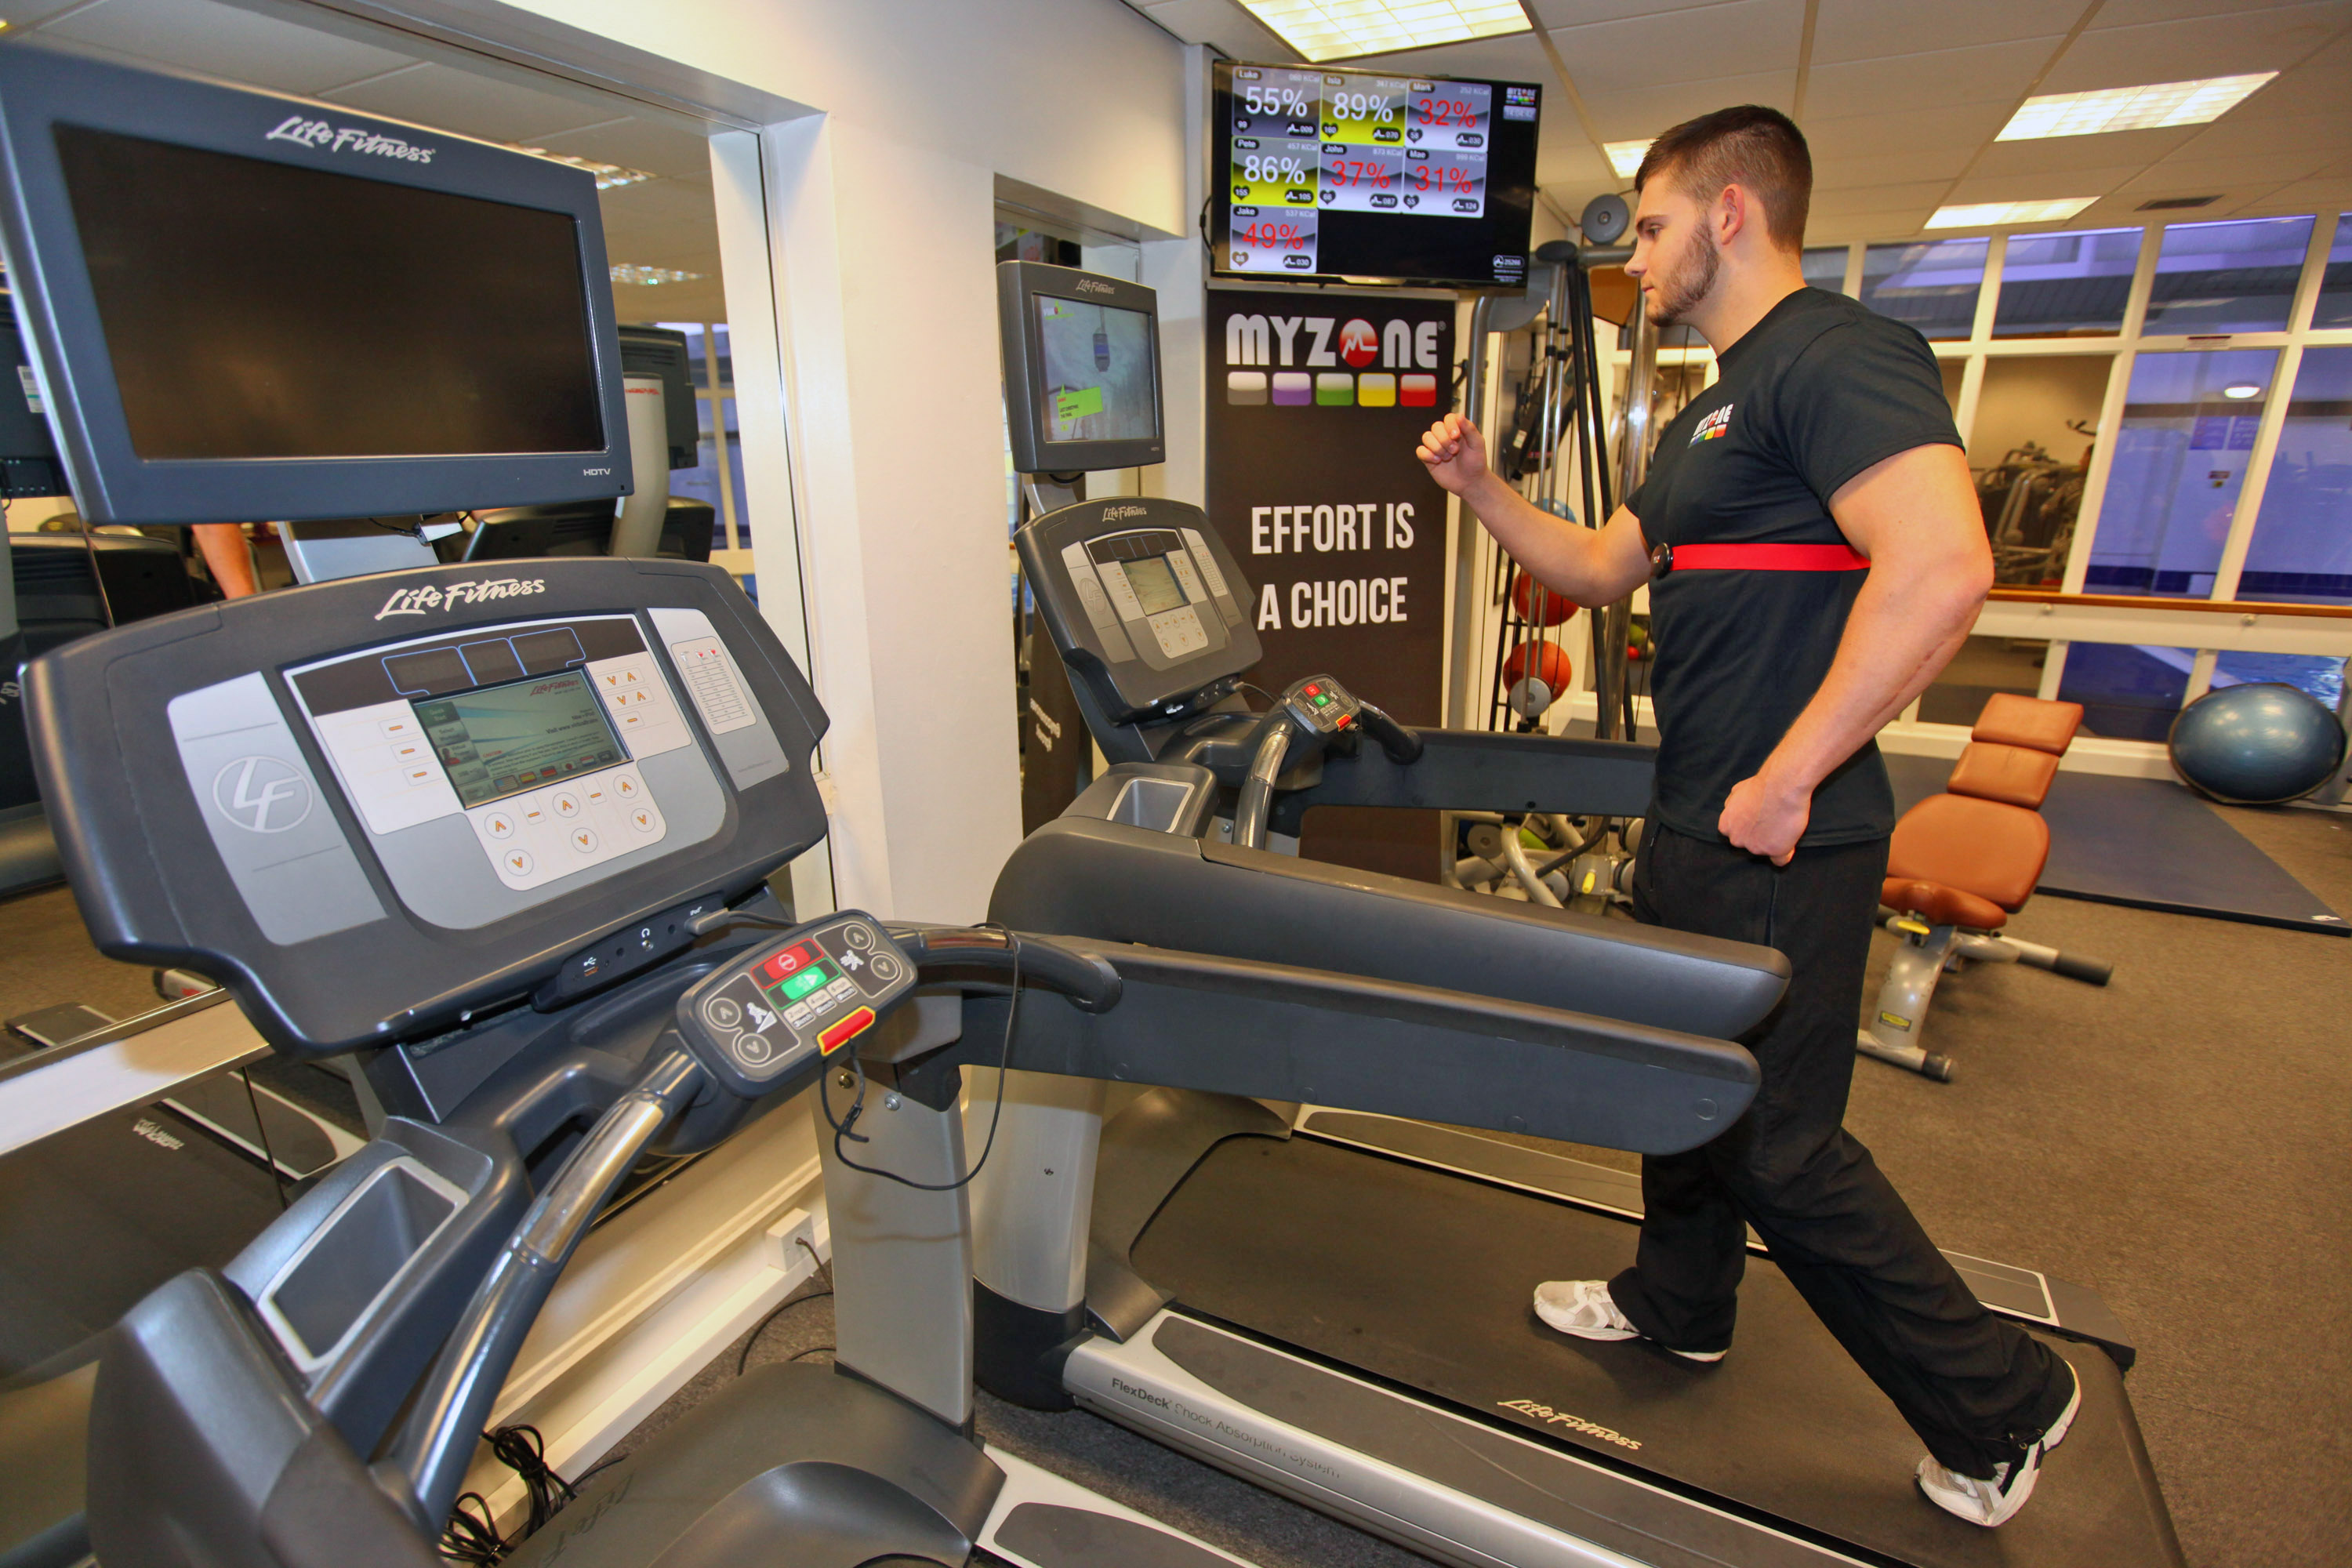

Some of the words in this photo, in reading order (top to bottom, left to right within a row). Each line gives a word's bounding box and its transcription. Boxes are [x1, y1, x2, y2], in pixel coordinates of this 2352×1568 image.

[1239, 70, 1258, 79] Luke
[1413, 82, 1432, 91] Mark
[1245, 86, 1308, 117] 55%
[1333, 92, 1393, 122] 89%
[1418, 99, 1476, 128] 32%
[266, 116, 335, 148] Life
[332, 128, 434, 163] Fitness
[1237, 139, 1256, 148] Pete
[1325, 145, 1344, 154] John
[1243, 154, 1306, 184] 86%
[1331, 160, 1391, 189] 37%
[1415, 165, 1472, 194] 31%
[1242, 222, 1304, 250] 49%
[1076, 278, 1091, 292] Life
[1102, 507, 1120, 522] Life
[1118, 506, 1147, 521] Fitness
[1252, 504, 1377, 554] EFFORT
[1386, 502, 1415, 549] IS
[374, 585, 444, 621] Life
[443, 579, 546, 612] Fitness
[1258, 583, 1282, 630] A
[1290, 576, 1408, 629] CHOICE
[530, 684, 550, 696] Life
[1112, 1377, 1169, 1410] FlexDeck
[1497, 1399, 1554, 1417] Life
[1547, 1413, 1642, 1450] Fitness
